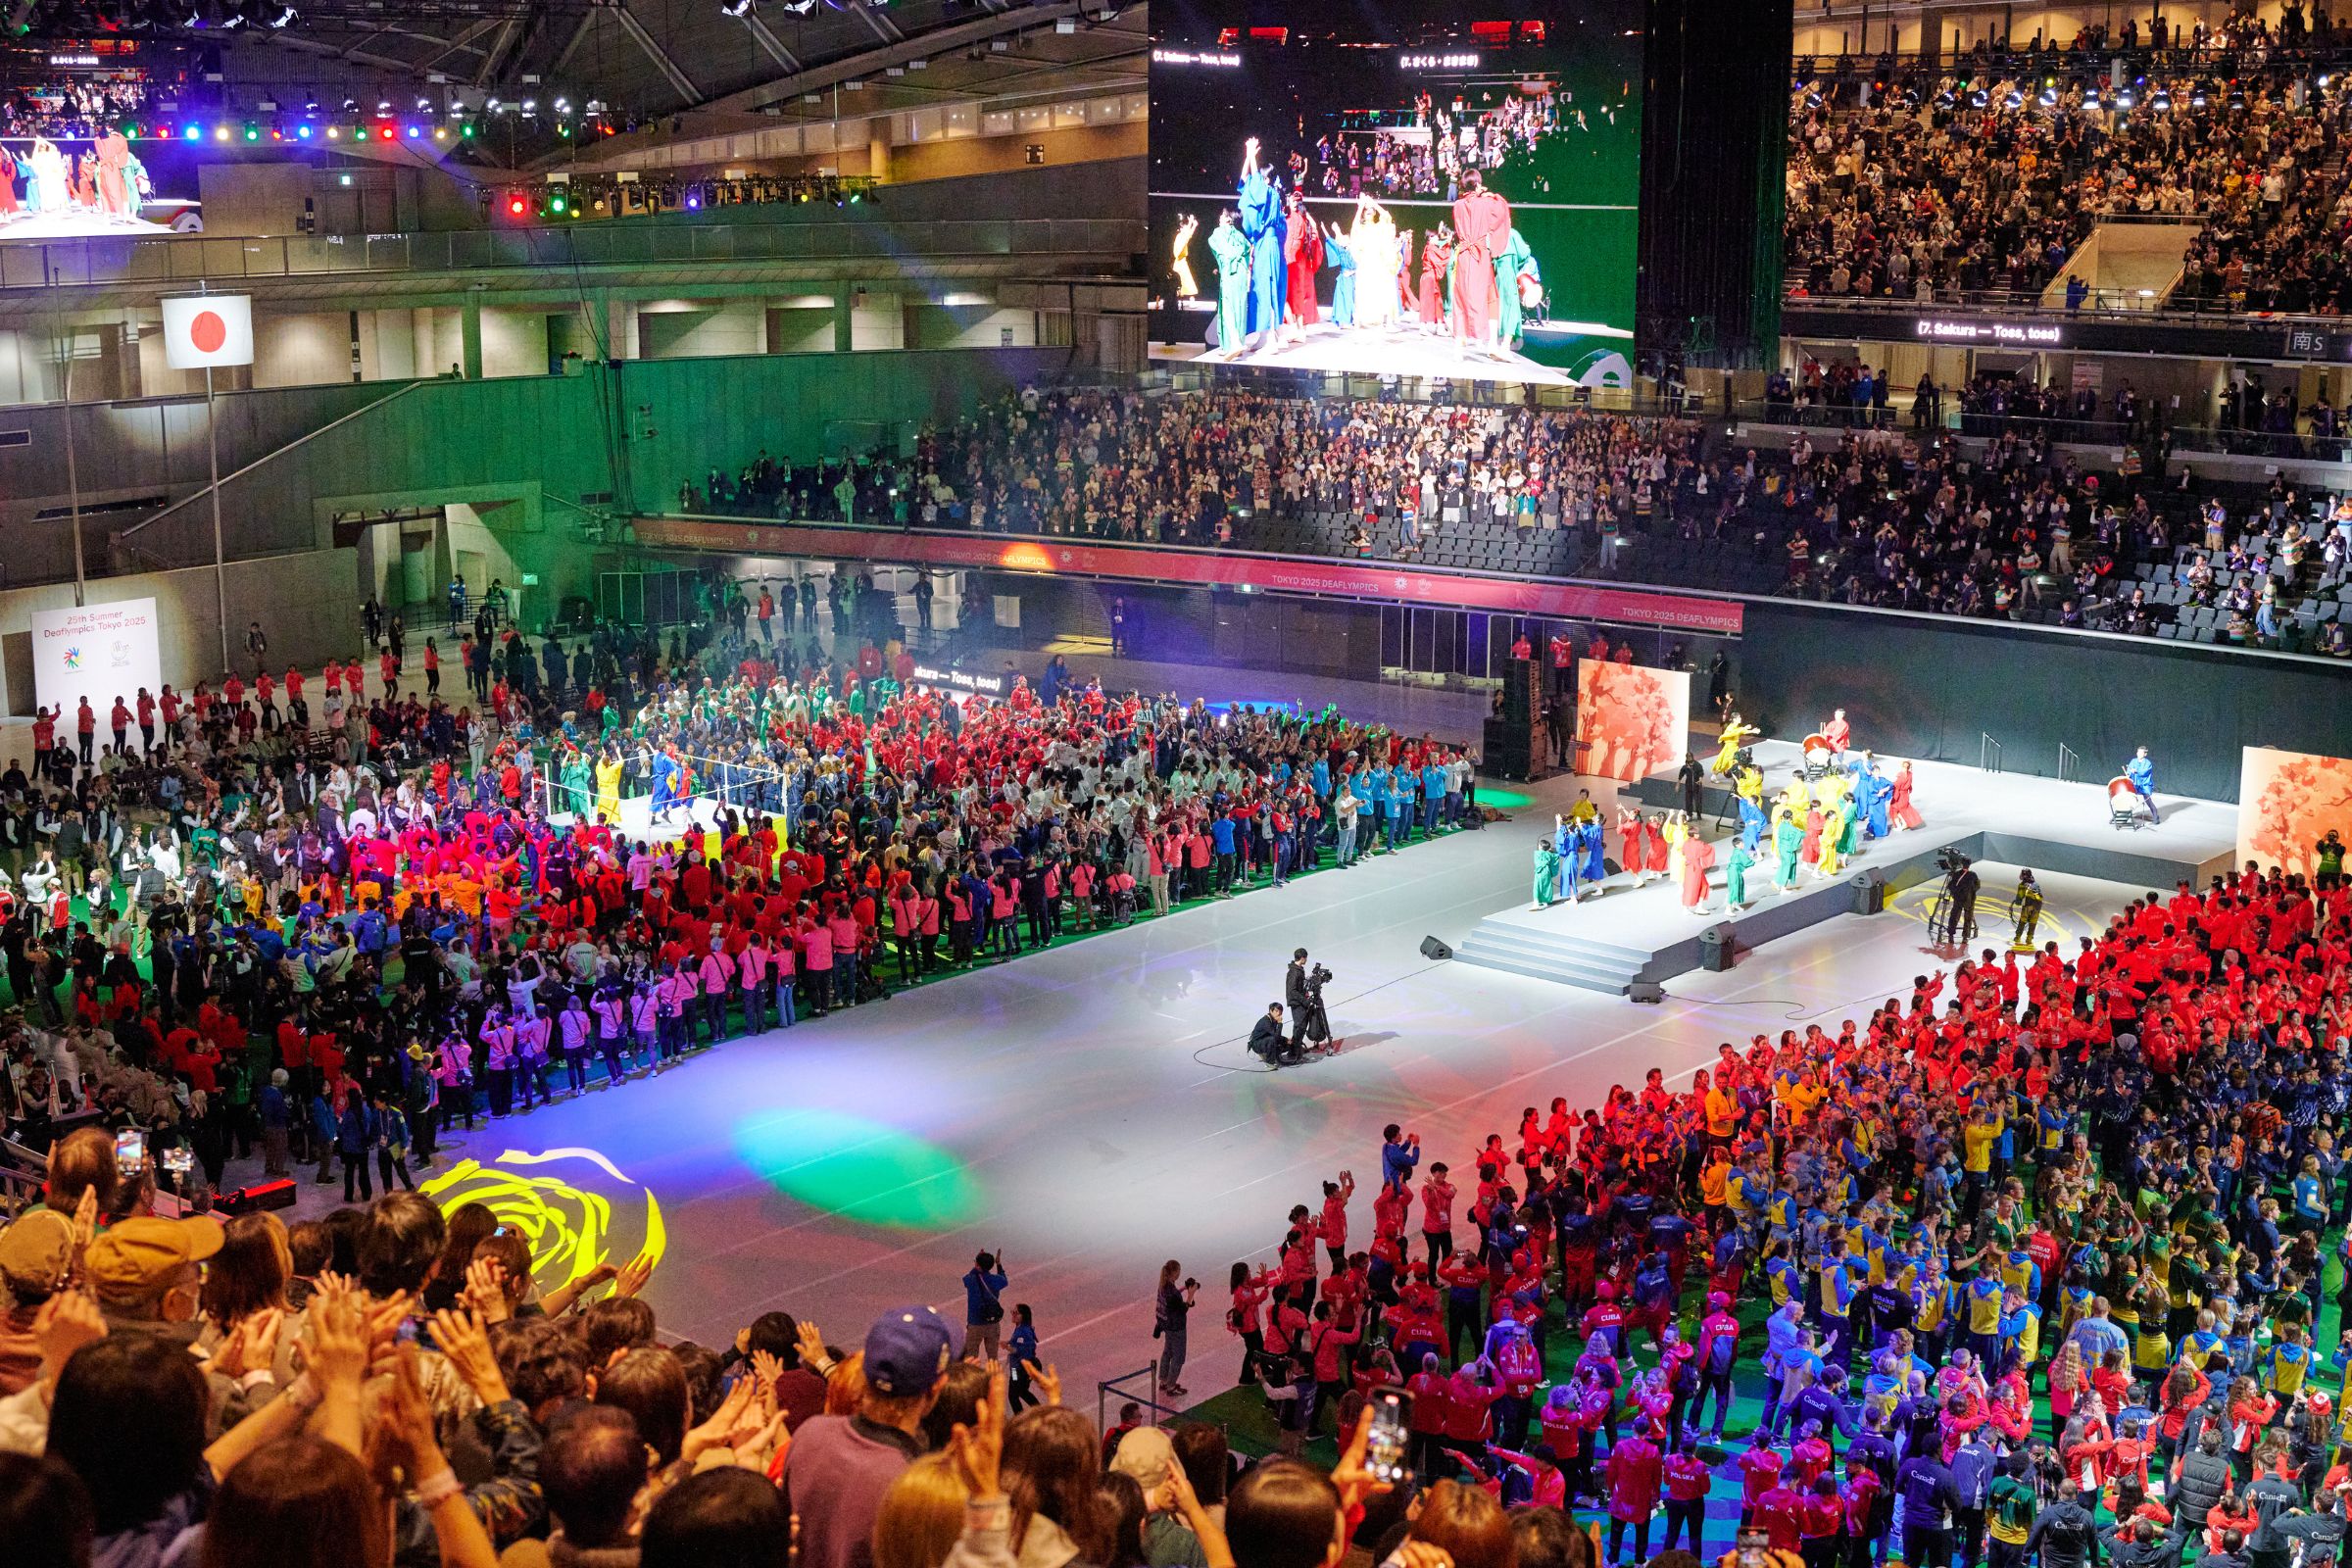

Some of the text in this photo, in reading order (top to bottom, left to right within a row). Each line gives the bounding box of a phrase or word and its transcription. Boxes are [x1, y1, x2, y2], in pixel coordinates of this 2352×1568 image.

[1918, 320, 1932, 335] (7.
[1934, 322, 1977, 337] Sakura
[1993, 324, 2026, 341] Toss,
[2028, 327, 2060, 342] toss)
[993, 554, 1047, 565] DEAFLYMPICS
[1272, 574, 1379, 593] TOKYO 2025 DEAFLYMPICS
[67, 612, 123, 625] 25th Summer
[1622, 607, 1740, 628] TOKYO 2025 DEAFLYMPICS
[44, 616, 146, 638] Deaflympics Tokyo 2025
[2031, 1244, 2051, 1253] GREAT
[1518, 1278, 1538, 1292] CUBA
[1600, 1313, 1621, 1322] CUBA
[1543, 1421, 1569, 1430] POLSKA
[1670, 1472, 1695, 1481] POLSKA
